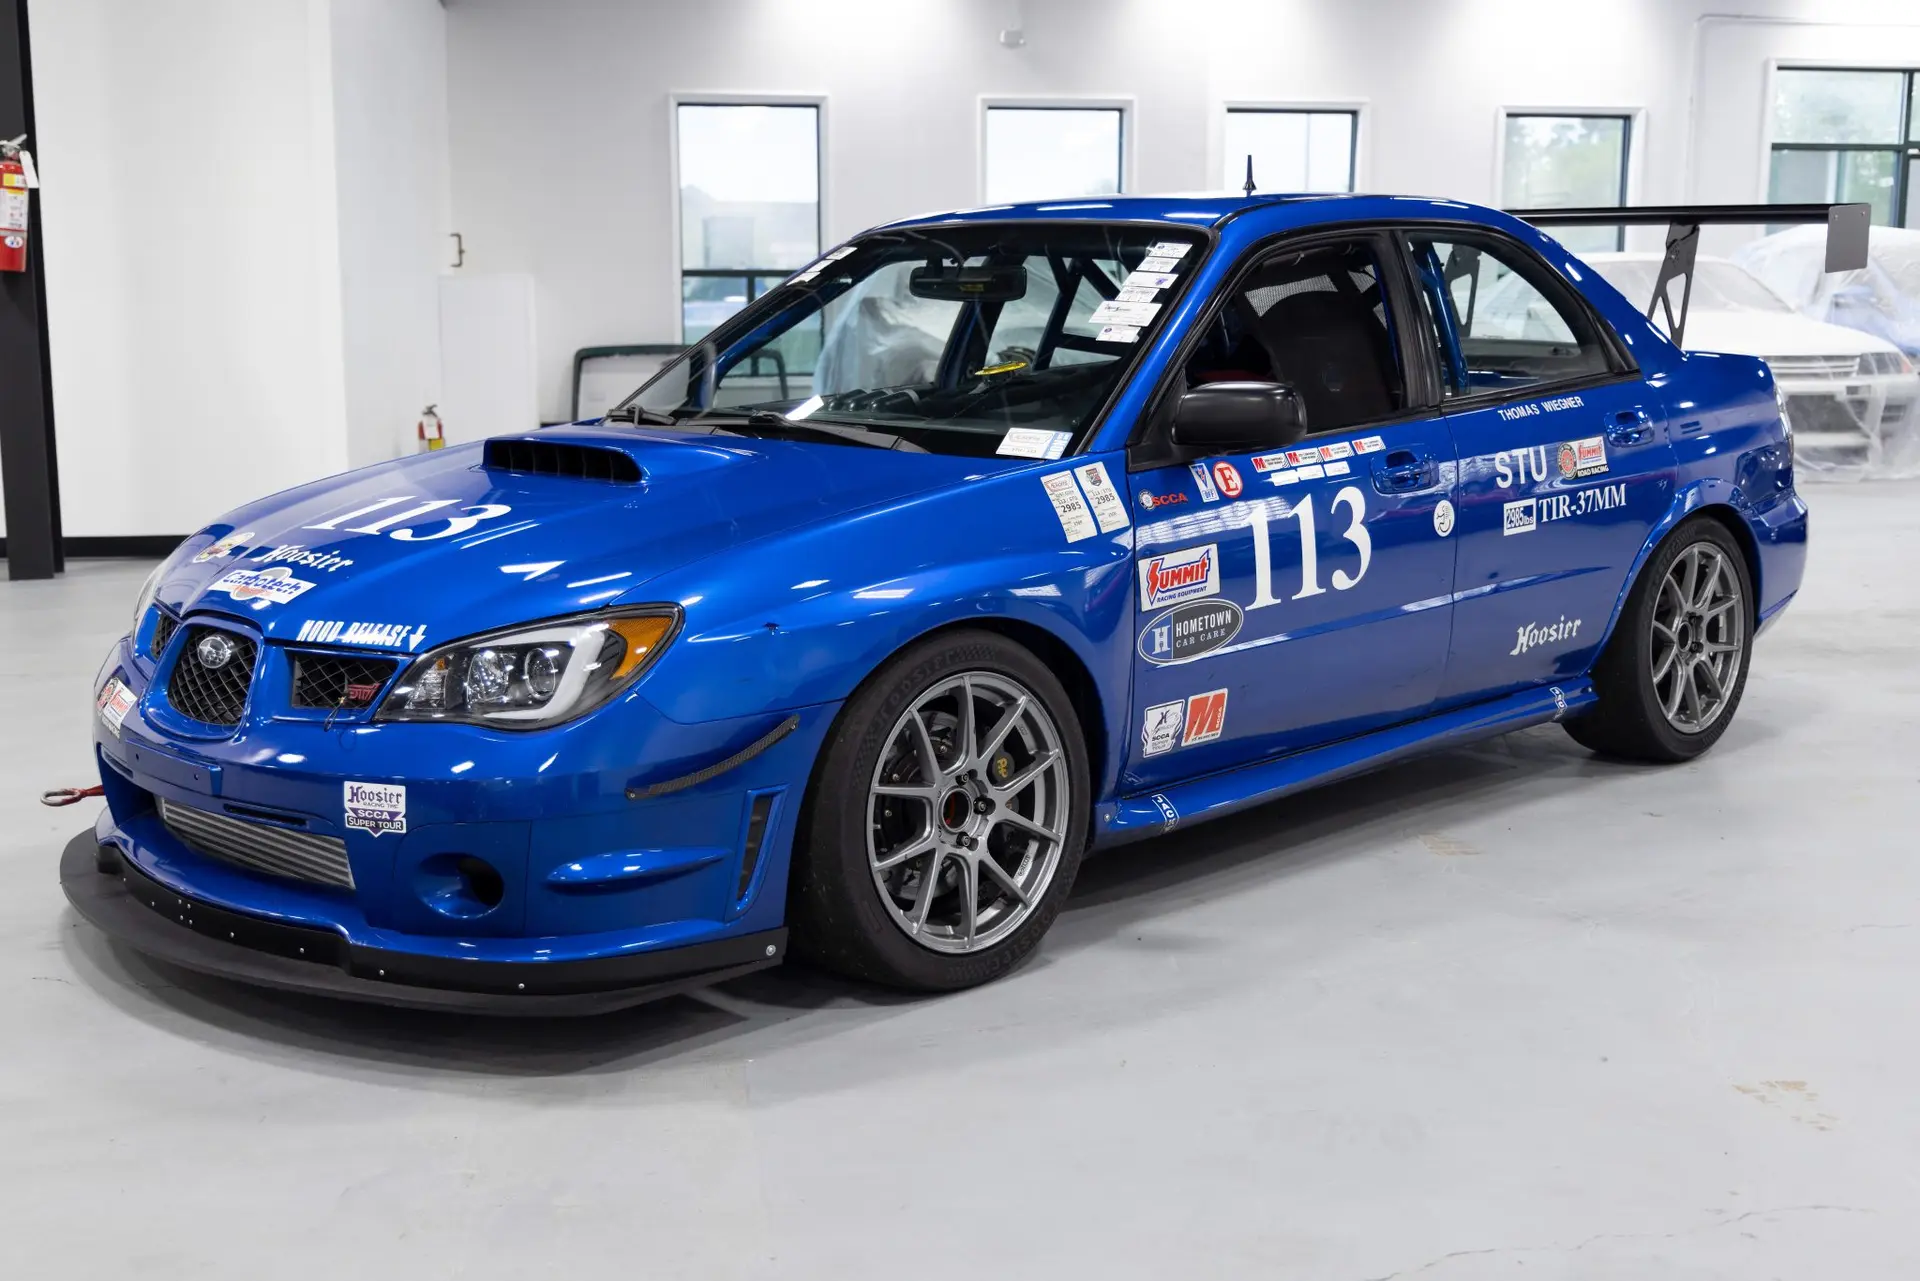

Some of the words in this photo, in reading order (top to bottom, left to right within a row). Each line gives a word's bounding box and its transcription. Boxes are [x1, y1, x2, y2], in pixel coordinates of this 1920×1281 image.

[1497, 403, 1540, 421] THOMAS
[1541, 396, 1584, 412] WIEGNER
[1216, 466, 1239, 493] E
[1494, 445, 1548, 489] STU
[1061, 501, 1082, 513] 2985
[1095, 493, 1115, 505] 2985
[1152, 492, 1188, 507] SCCA
[1538, 483, 1627, 523] TIR-37MM
[301, 495, 512, 541] 113
[251, 544, 354, 572] Hoosier
[1245, 486, 1372, 611] 113
[1148, 553, 1210, 600] SUMMIT
[1156, 592, 1177, 603] RACING
[1177, 585, 1207, 598] EQUIPMENT
[296, 619, 345, 642] HOOD
[1175, 610, 1232, 637] HOMETOWN
[1509, 615, 1582, 656] Hoosier
[1175, 636, 1196, 648] CAR
[1200, 628, 1227, 642] CARE
[347, 785, 402, 804] Hoosier
[348, 817, 376, 828] SUPER
[377, 821, 402, 830] TOUR
[358, 809, 390, 819] SCCA
